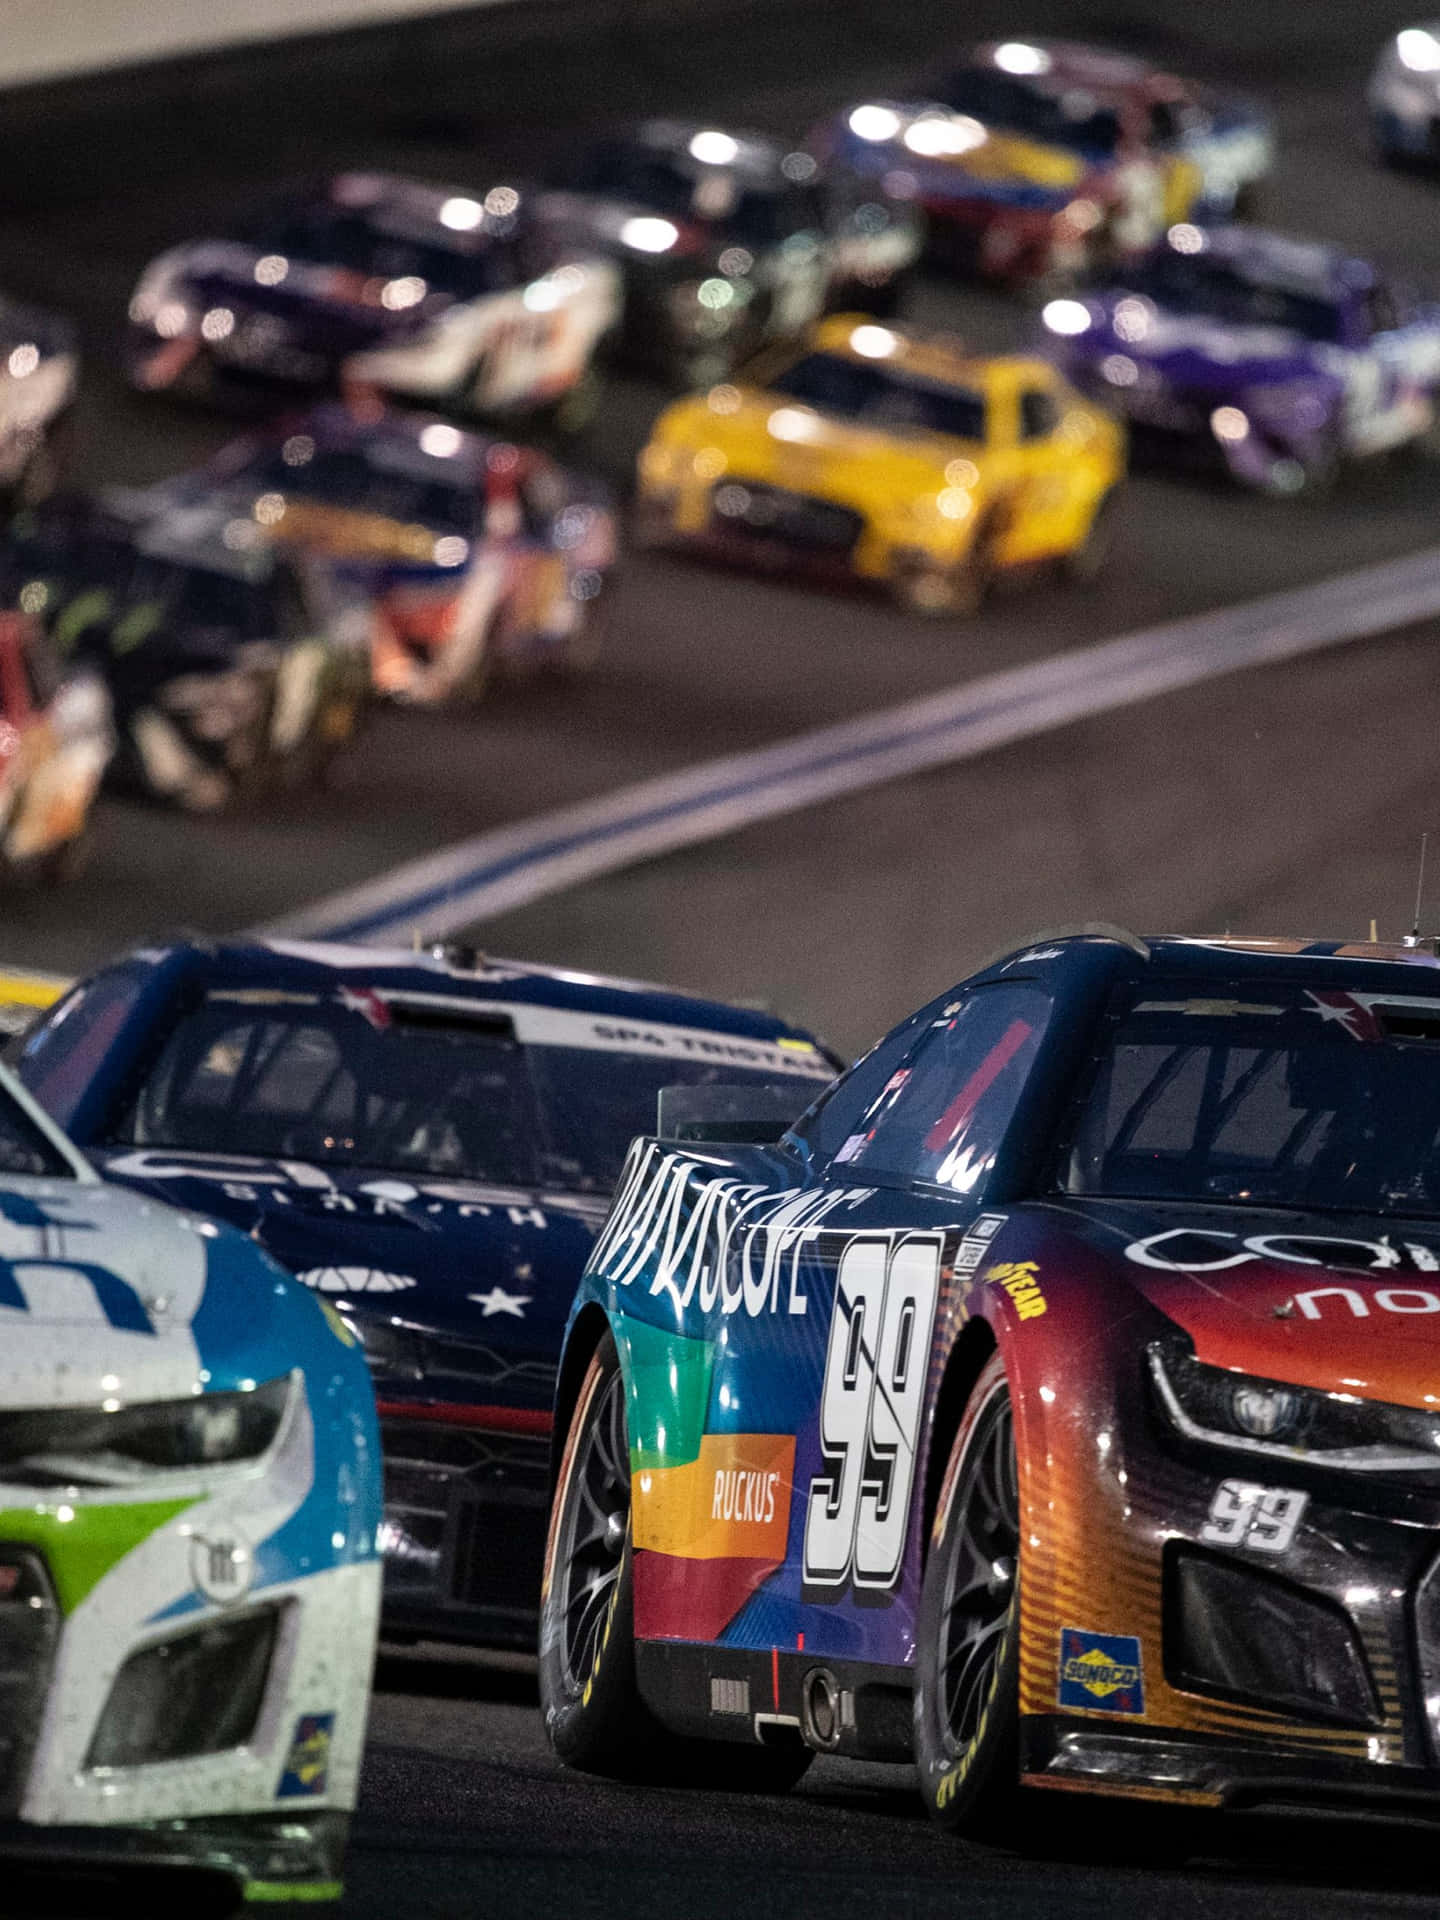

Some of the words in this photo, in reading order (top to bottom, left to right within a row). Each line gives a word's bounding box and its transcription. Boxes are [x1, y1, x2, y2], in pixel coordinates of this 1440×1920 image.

[803, 1230, 946, 1588] 99
[711, 1469, 777, 1523] RUCKUS
[1201, 1478, 1308, 1553] 99
[1064, 1657, 1138, 1688] SUNOCO
